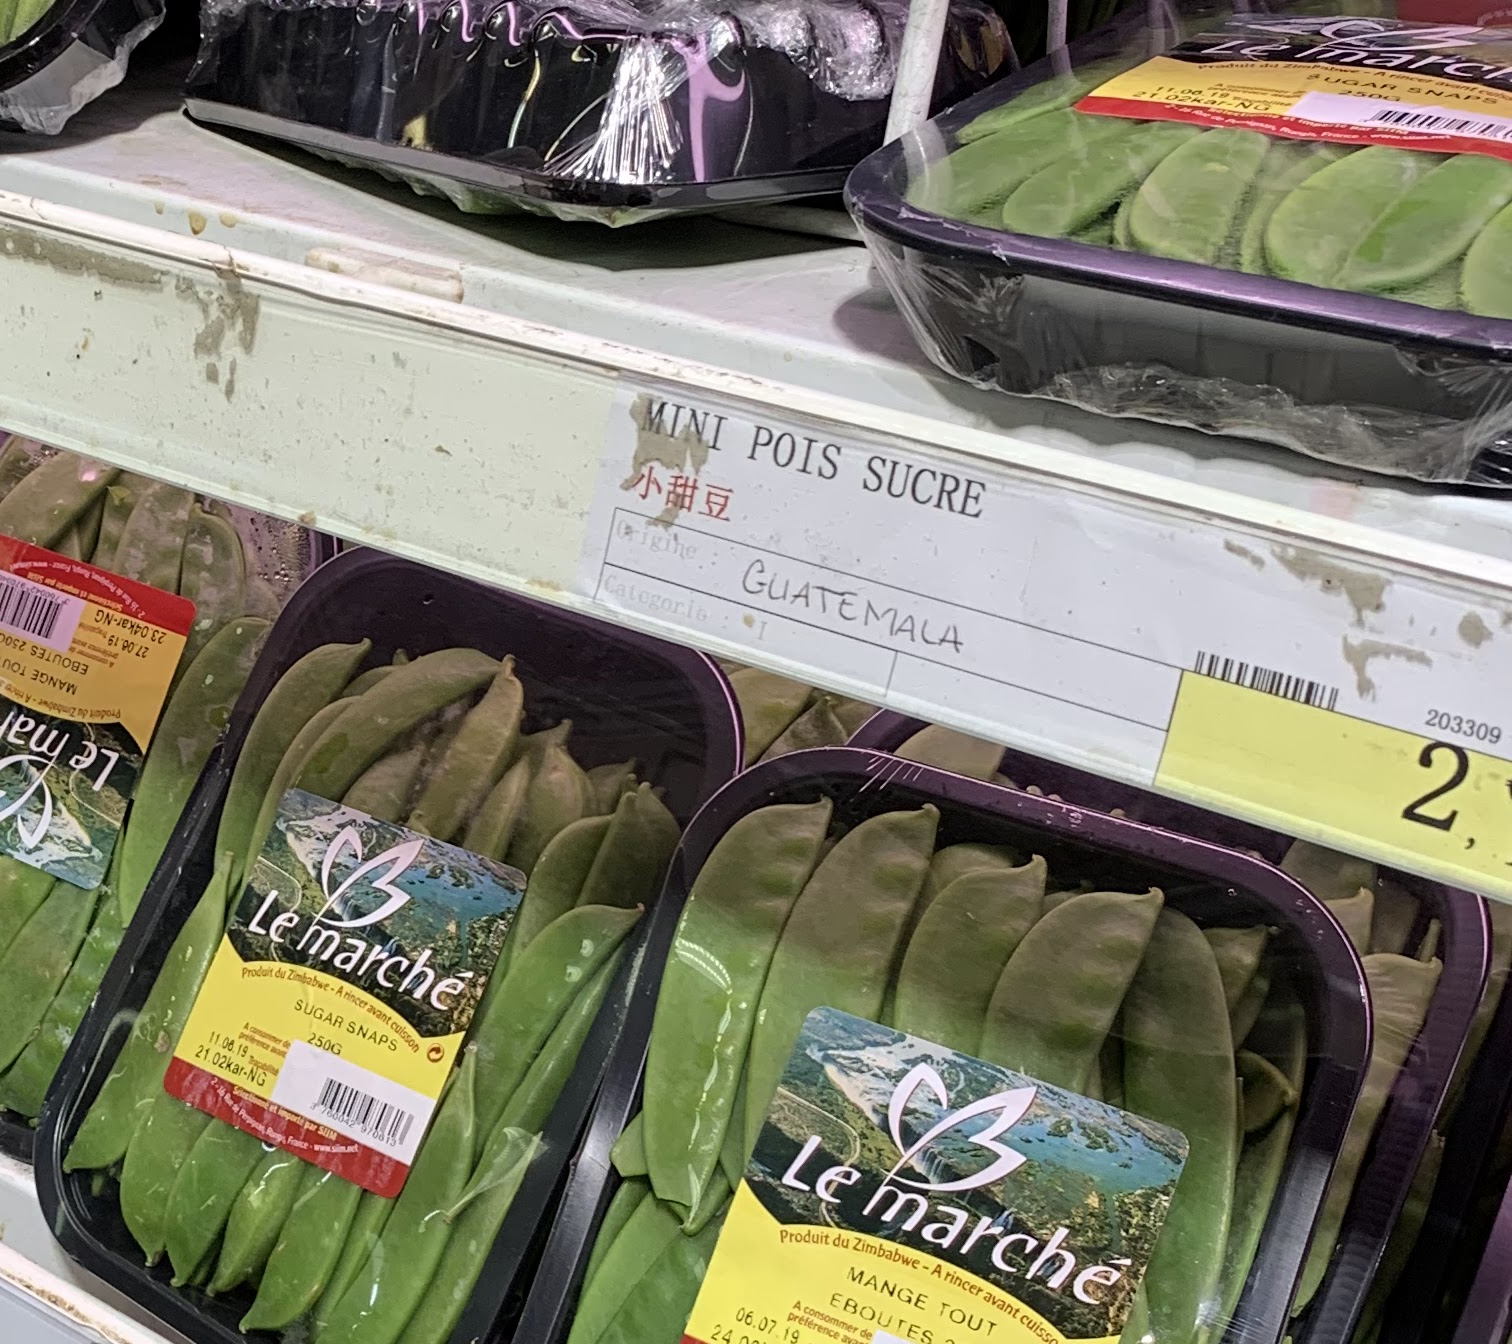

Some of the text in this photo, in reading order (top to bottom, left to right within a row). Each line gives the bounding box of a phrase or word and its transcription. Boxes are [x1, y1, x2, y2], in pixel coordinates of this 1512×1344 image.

[1306, 73, 1498, 105] SUGAR SNAPS
[640, 398, 986, 520] MINI POIS SUCRE
[631, 464, 735, 523] 小甜豆
[29, 645, 90, 675] EBOUTES
[30, 672, 79, 696] MANGE
[1424, 708, 1503, 745] 203309
[69, 740, 120, 792] Le
[247, 889, 474, 1011] Le marché
[241, 966, 273, 979] Produit
[275, 969, 287, 979] du
[287, 969, 330, 991] Zimbabwe
[390, 1019, 420, 1053] cuisson
[294, 999, 399, 1052] SUGAR SNAPS
[195, 1044, 268, 1087] 21.02kar-NG
[307, 1033, 343, 1056] 250G
[781, 1134, 1133, 1305] Le marché
[779, 1229, 830, 1244] Produit
[833, 1233, 849, 1249] du
[851, 1236, 920, 1270] Zimbabwe
[946, 1270, 984, 1297] rincer
[982, 1290, 1021, 1320] avant
[787, 1311, 840, 1340] préférence
[792, 1299, 873, 1341] A consommer de
[846, 1265, 999, 1338] MANGE TOUT
